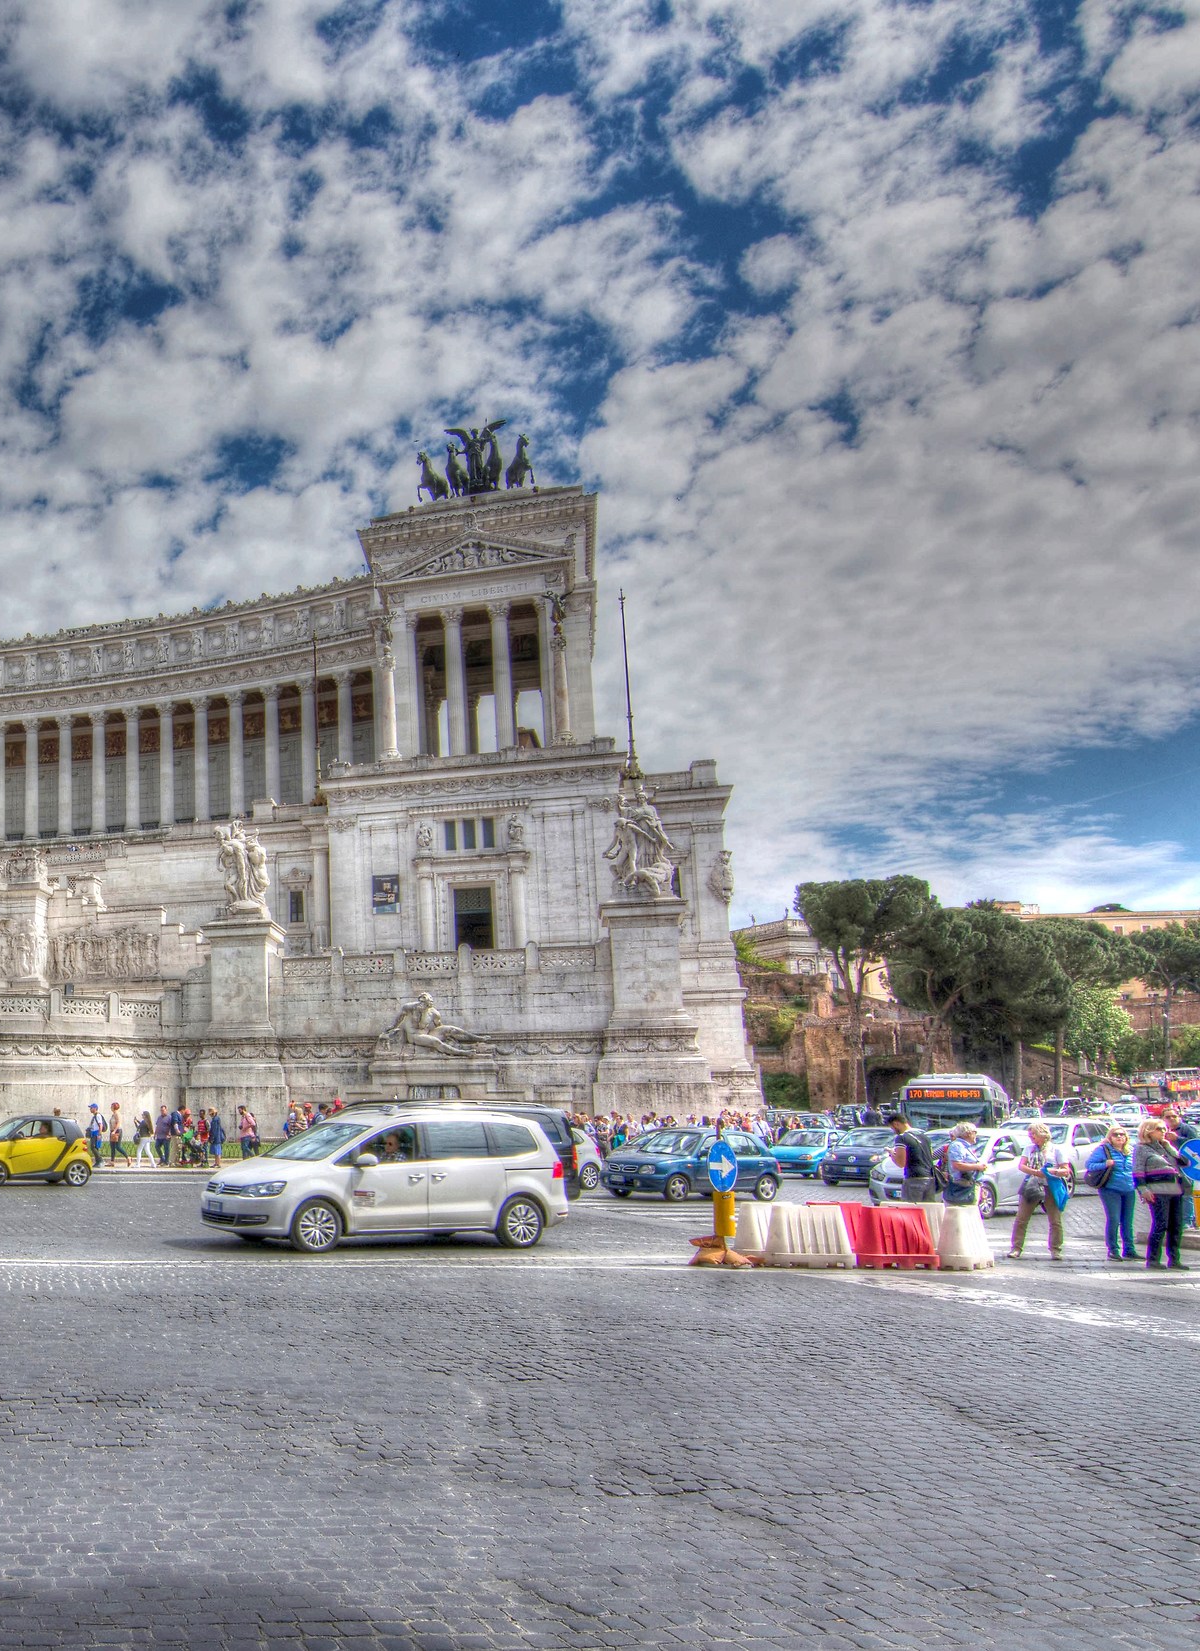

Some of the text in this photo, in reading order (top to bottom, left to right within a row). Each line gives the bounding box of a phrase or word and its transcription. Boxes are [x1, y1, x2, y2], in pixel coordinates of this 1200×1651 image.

[421, 582, 528, 604] CIVIVM LIBERTATI
[909, 1089, 922, 1099] 170
